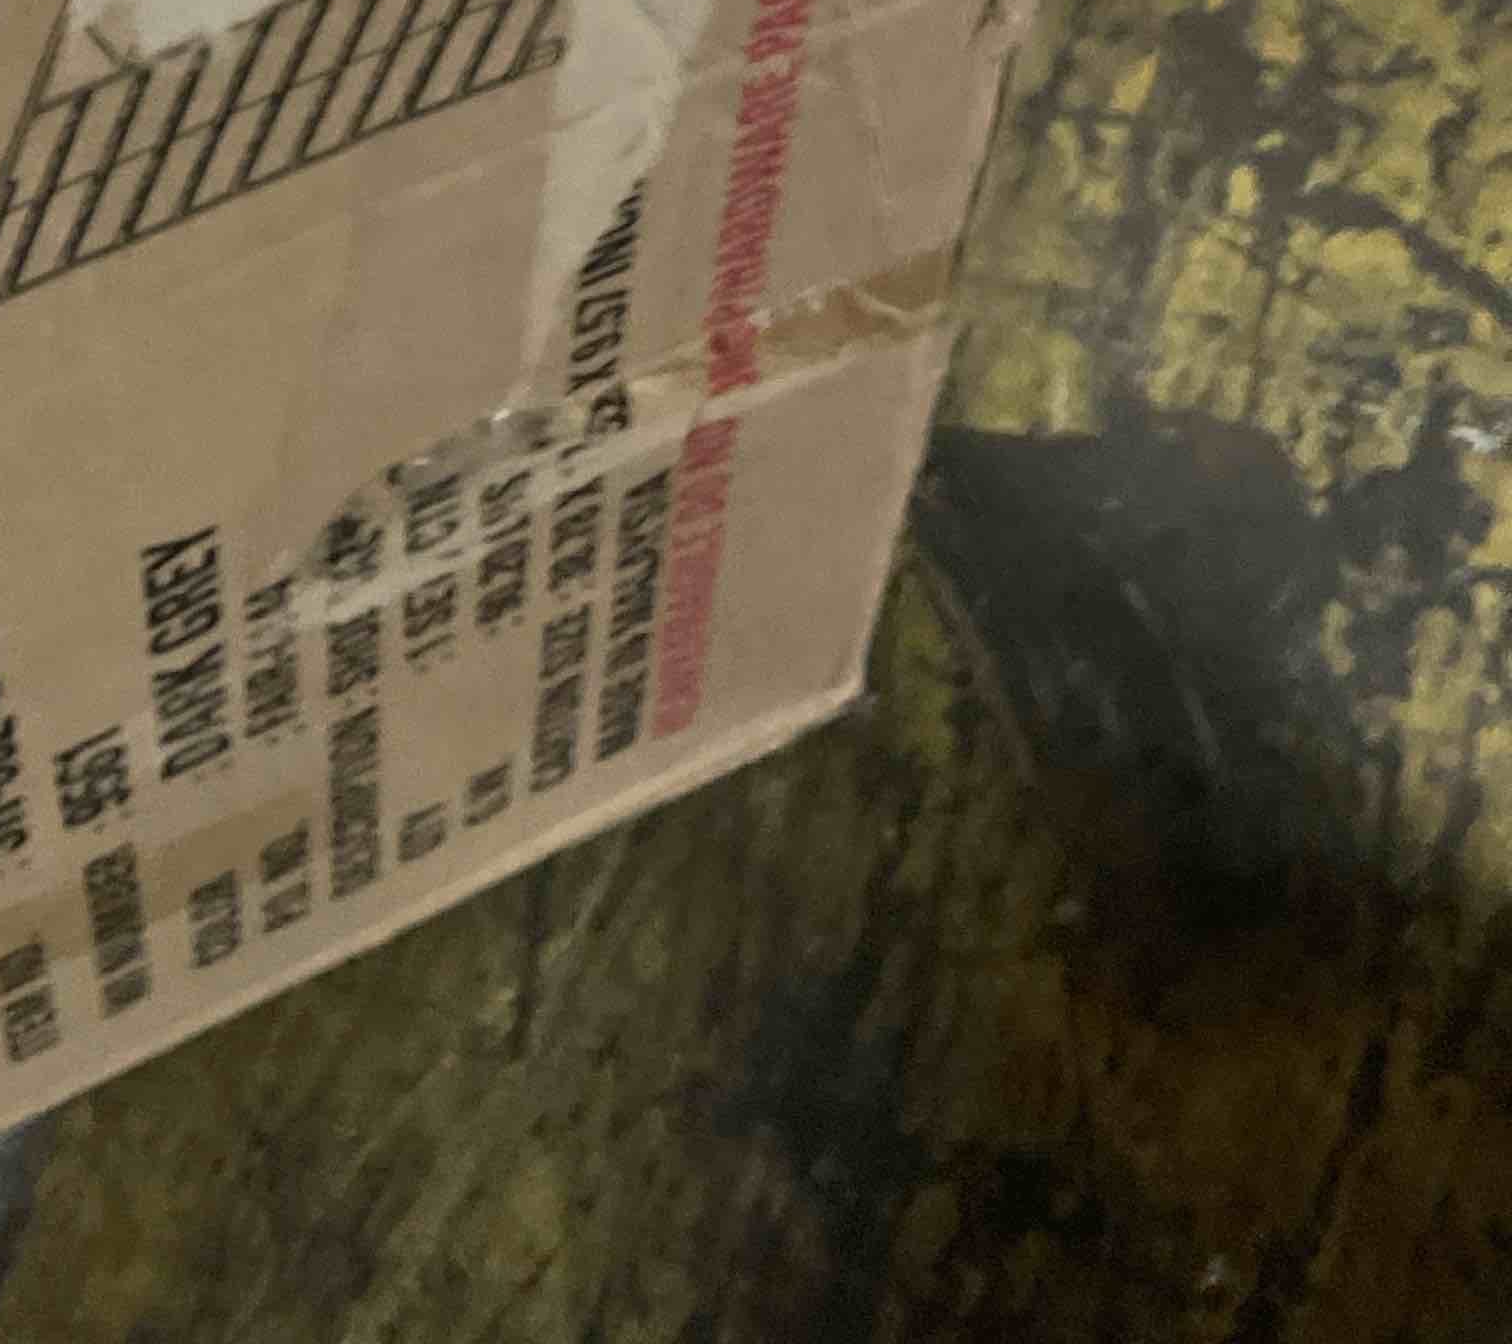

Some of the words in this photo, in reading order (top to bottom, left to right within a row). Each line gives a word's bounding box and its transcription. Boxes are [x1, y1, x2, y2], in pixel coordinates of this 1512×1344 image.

[568, 288, 630, 364] 9.57
[140, 523, 226, 656] GREY
[149, 643, 232, 783] DARK
